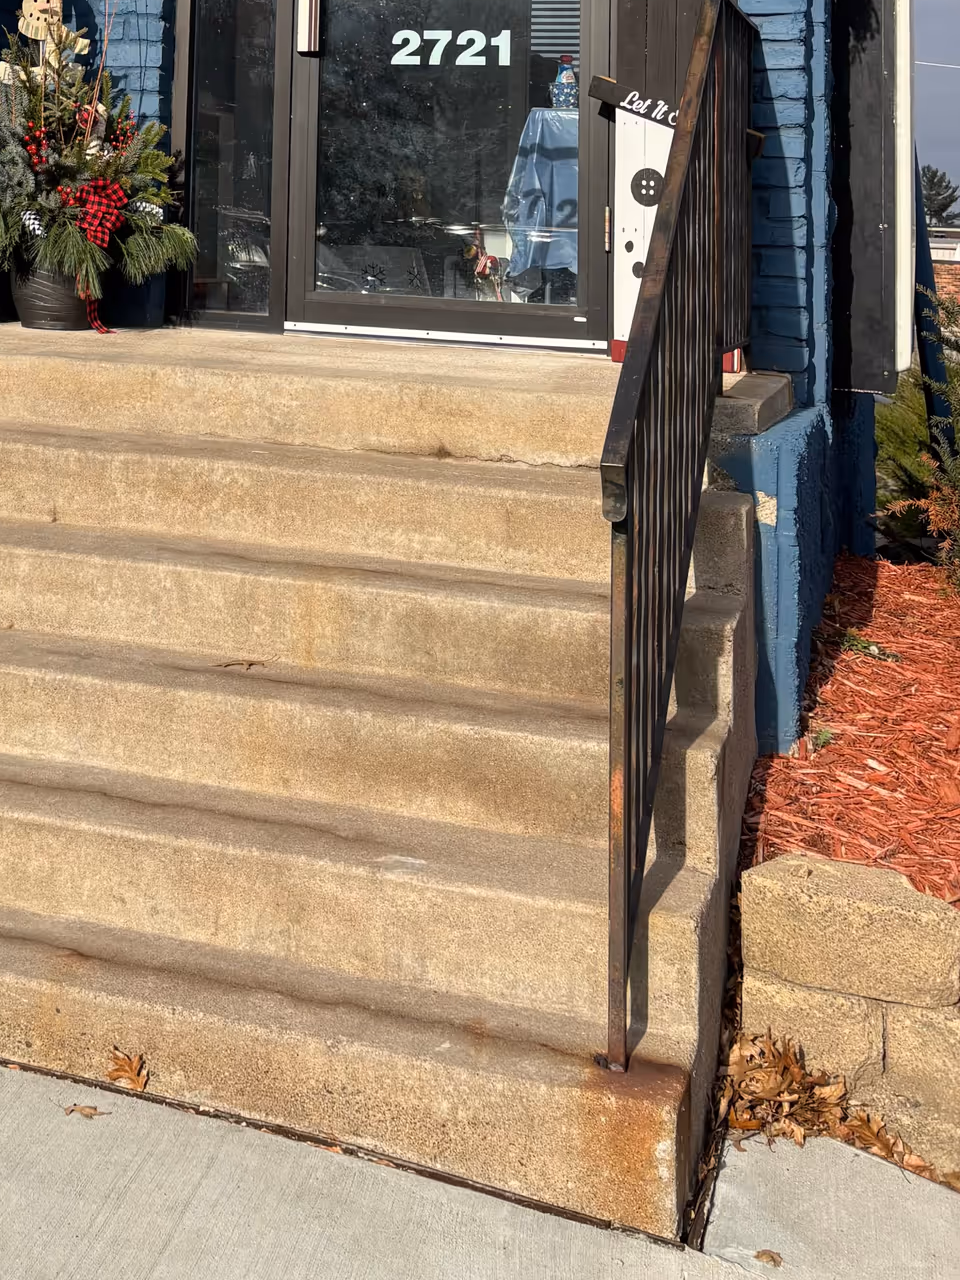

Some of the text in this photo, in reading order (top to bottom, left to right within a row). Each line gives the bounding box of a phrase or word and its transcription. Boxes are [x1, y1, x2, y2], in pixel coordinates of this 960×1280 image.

[390, 29, 511, 66] 2721
[620, 91, 649, 114] Let
[651, 100, 668, 120] It
